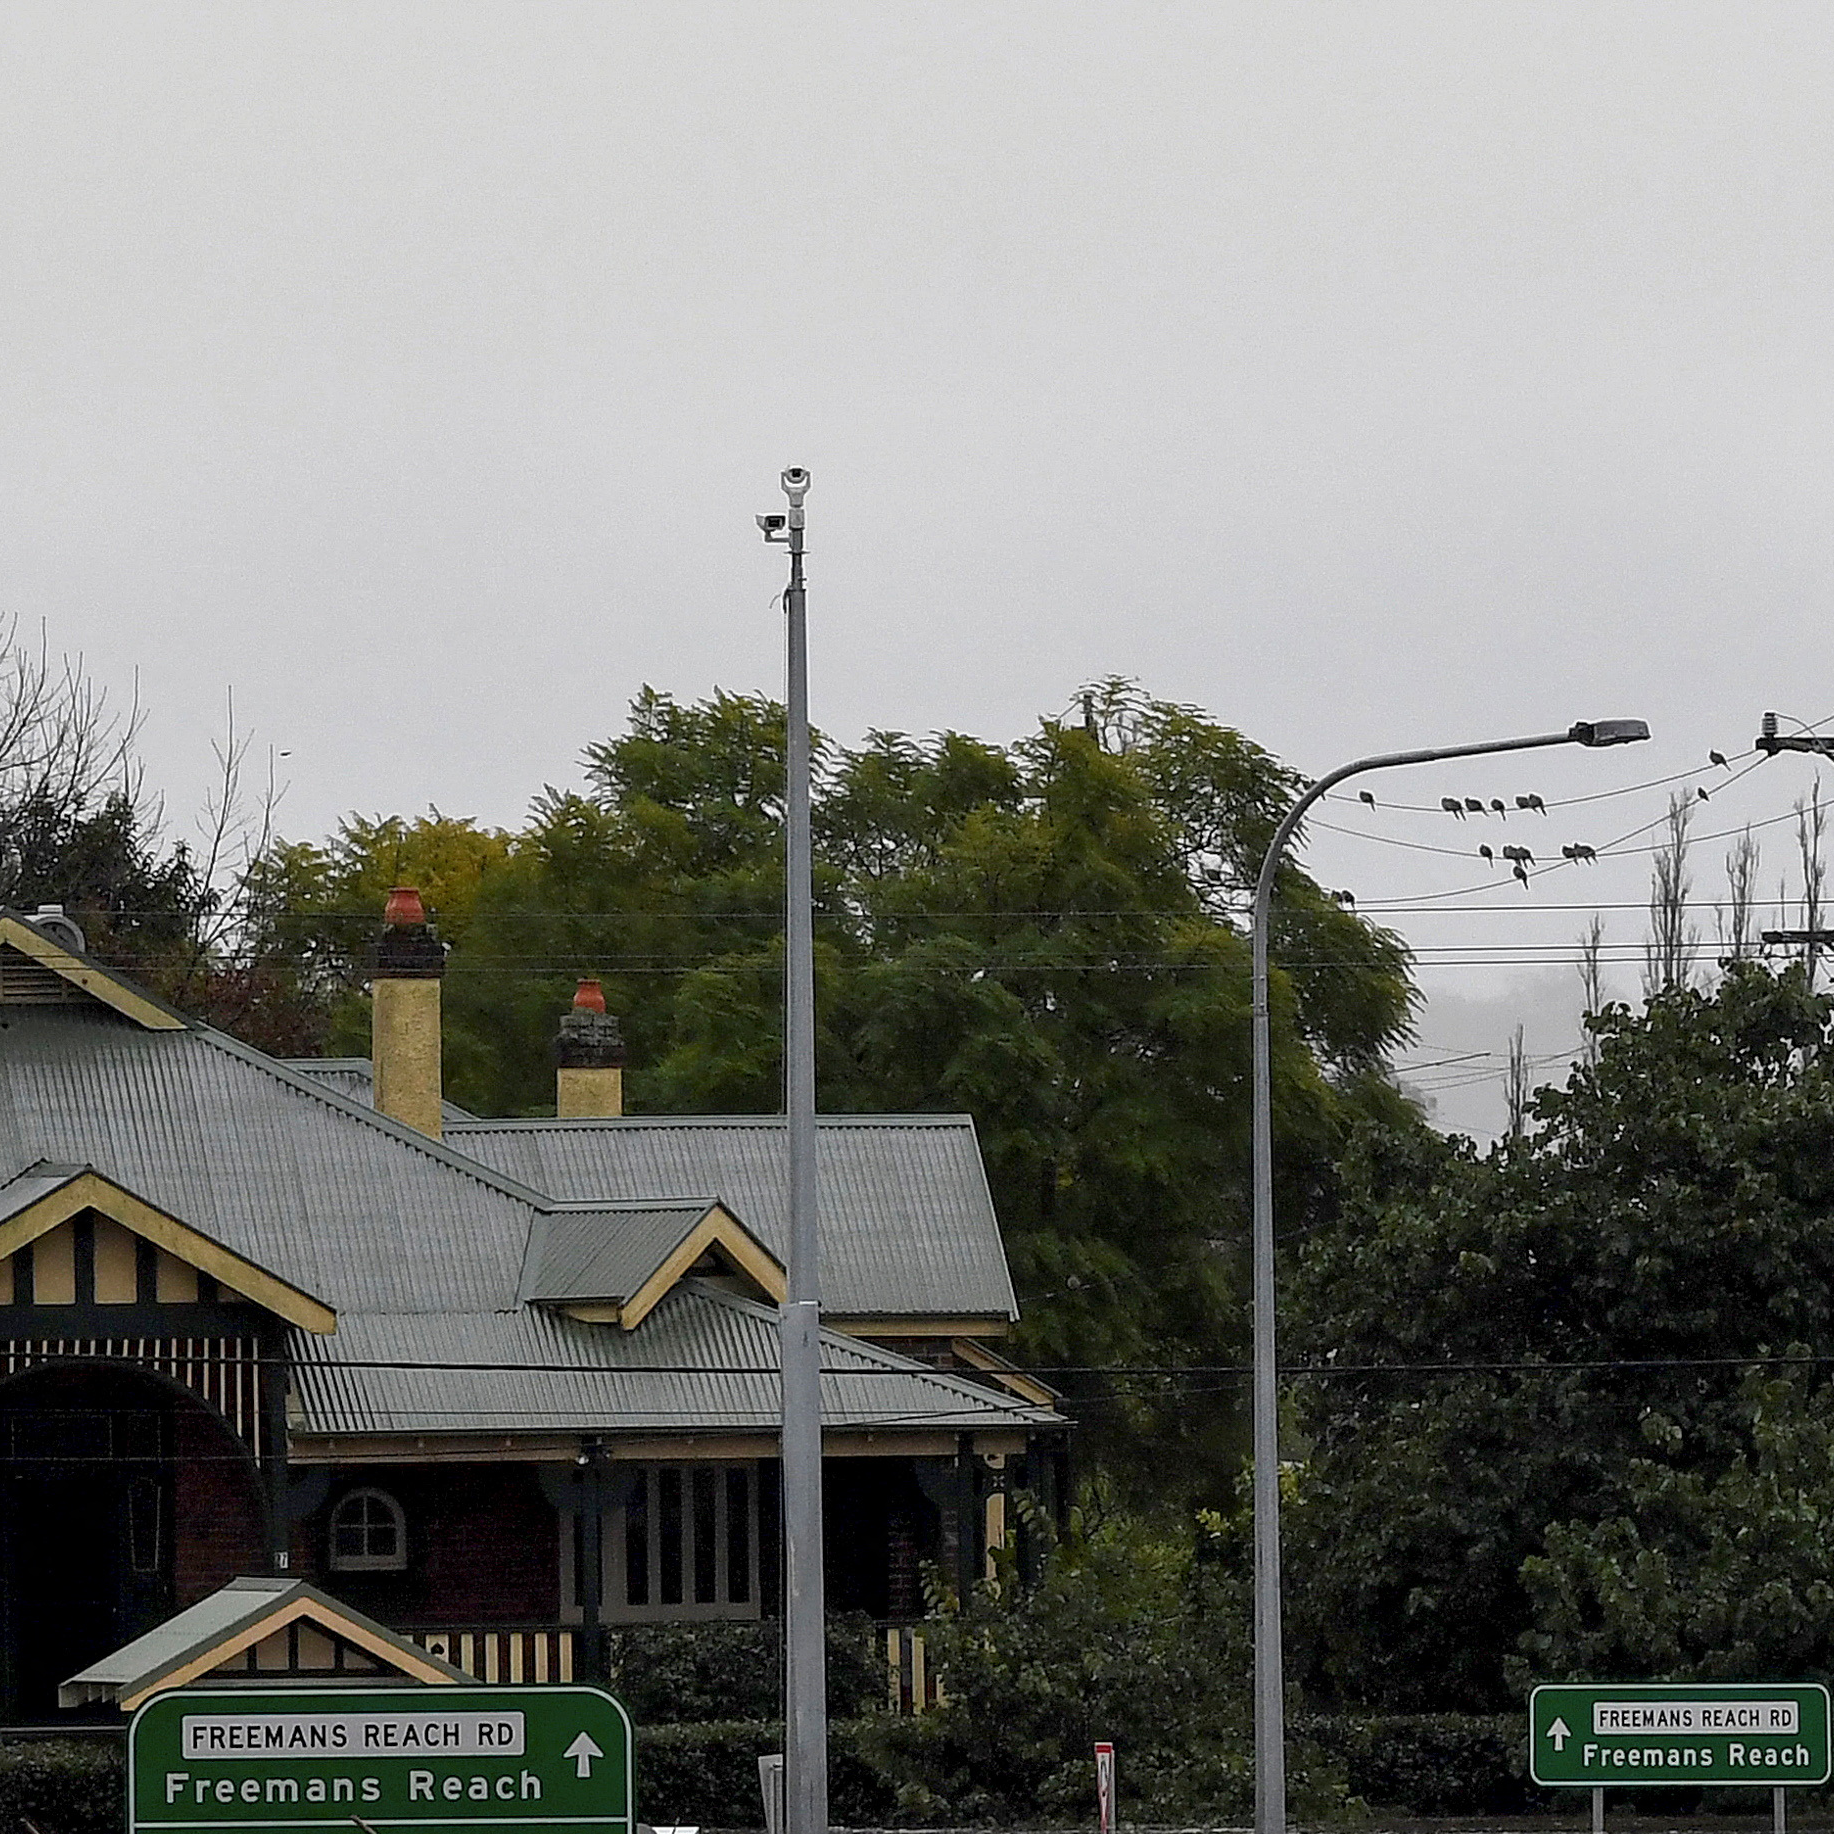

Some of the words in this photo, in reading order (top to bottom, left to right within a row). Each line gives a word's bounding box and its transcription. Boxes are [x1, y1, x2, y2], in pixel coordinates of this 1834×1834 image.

[1599, 1709, 1693, 1728] FREEMANS
[1702, 1709, 1760, 1727] REACH
[1770, 1709, 1793, 1727] RD
[192, 1724, 347, 1750] FREEMANS
[364, 1723, 460, 1748] REACH
[478, 1722, 514, 1746] RD
[1583, 1743, 1714, 1767] Freemans
[1729, 1742, 1810, 1767] Reach
[166, 1771, 381, 1804] Freemans
[409, 1768, 543, 1802] Reach
